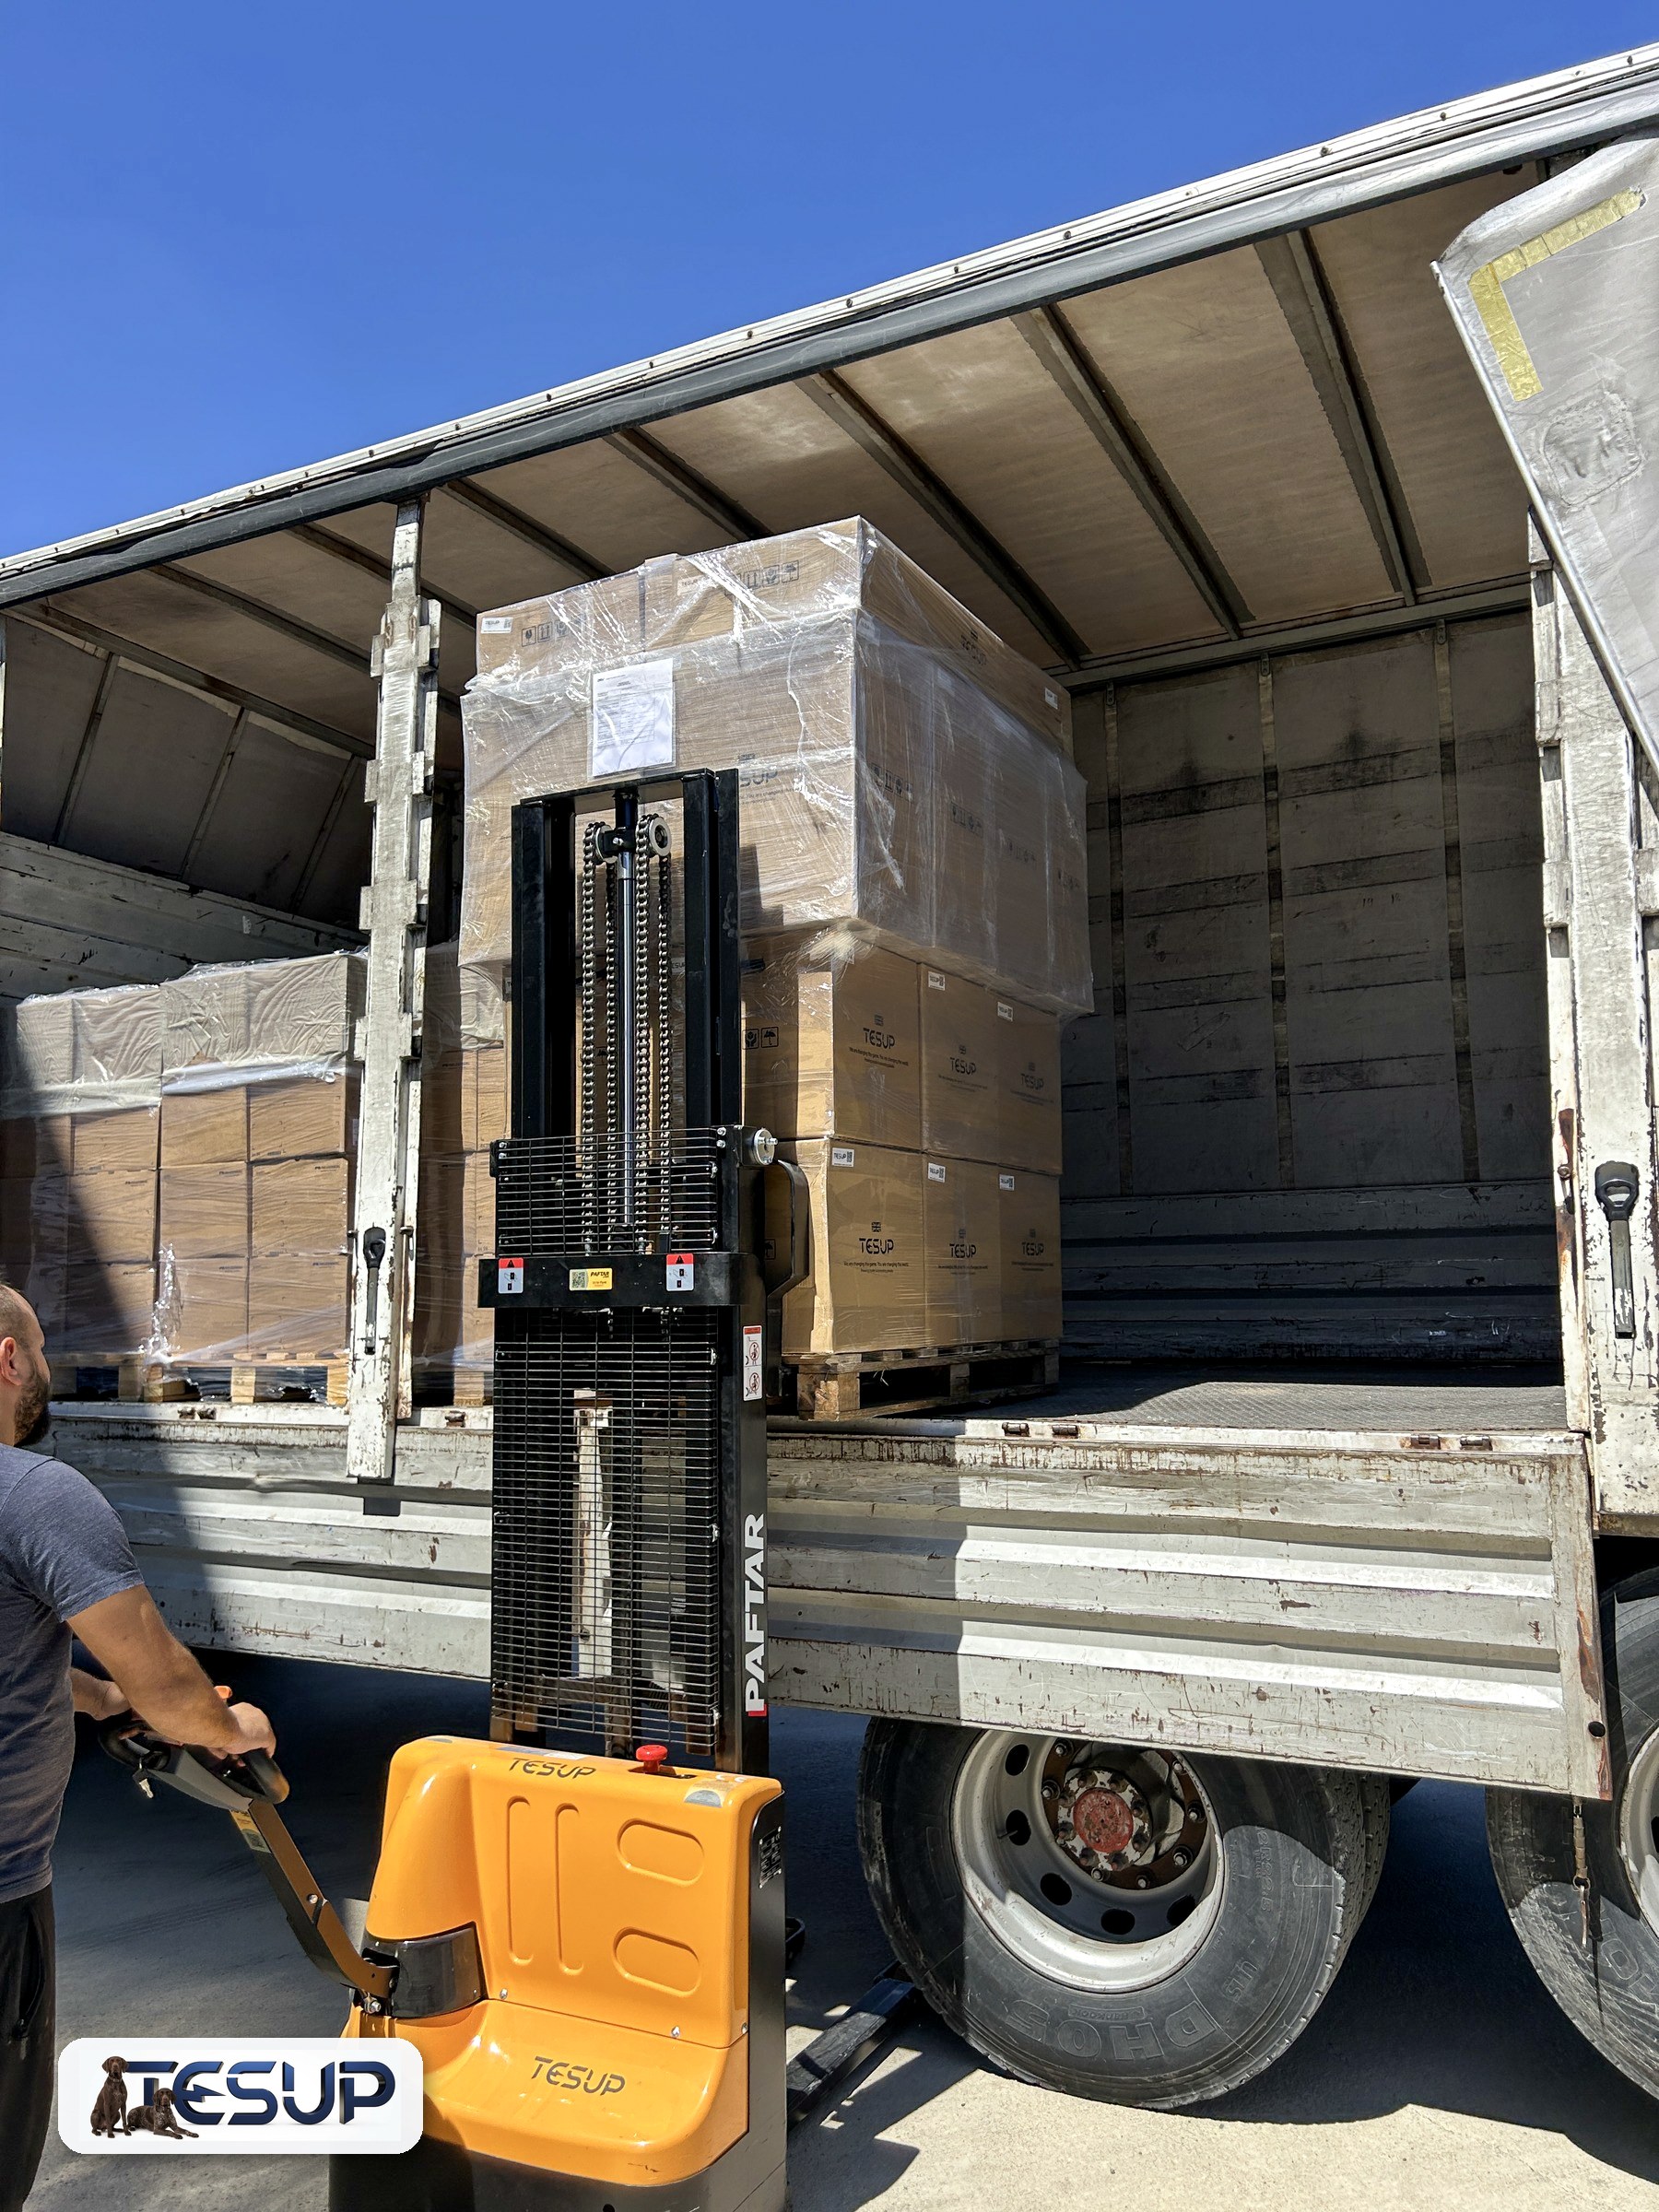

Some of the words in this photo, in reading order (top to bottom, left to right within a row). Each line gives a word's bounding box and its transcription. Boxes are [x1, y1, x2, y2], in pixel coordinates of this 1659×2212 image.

[739, 771, 778, 787] SUP
[863, 1027, 896, 1050] TESUP
[949, 1056, 977, 1075] TESUP
[1020, 1073, 1044, 1091] TESUP
[858, 1238, 894, 1254] TESUP
[949, 1243, 977, 1259] TESUP
[1021, 1241, 1044, 1256] TESUP
[745, 1513, 765, 1712] PAFTAR
[509, 1757, 597, 1780] TESUP
[531, 2055, 626, 2097] TESUP
